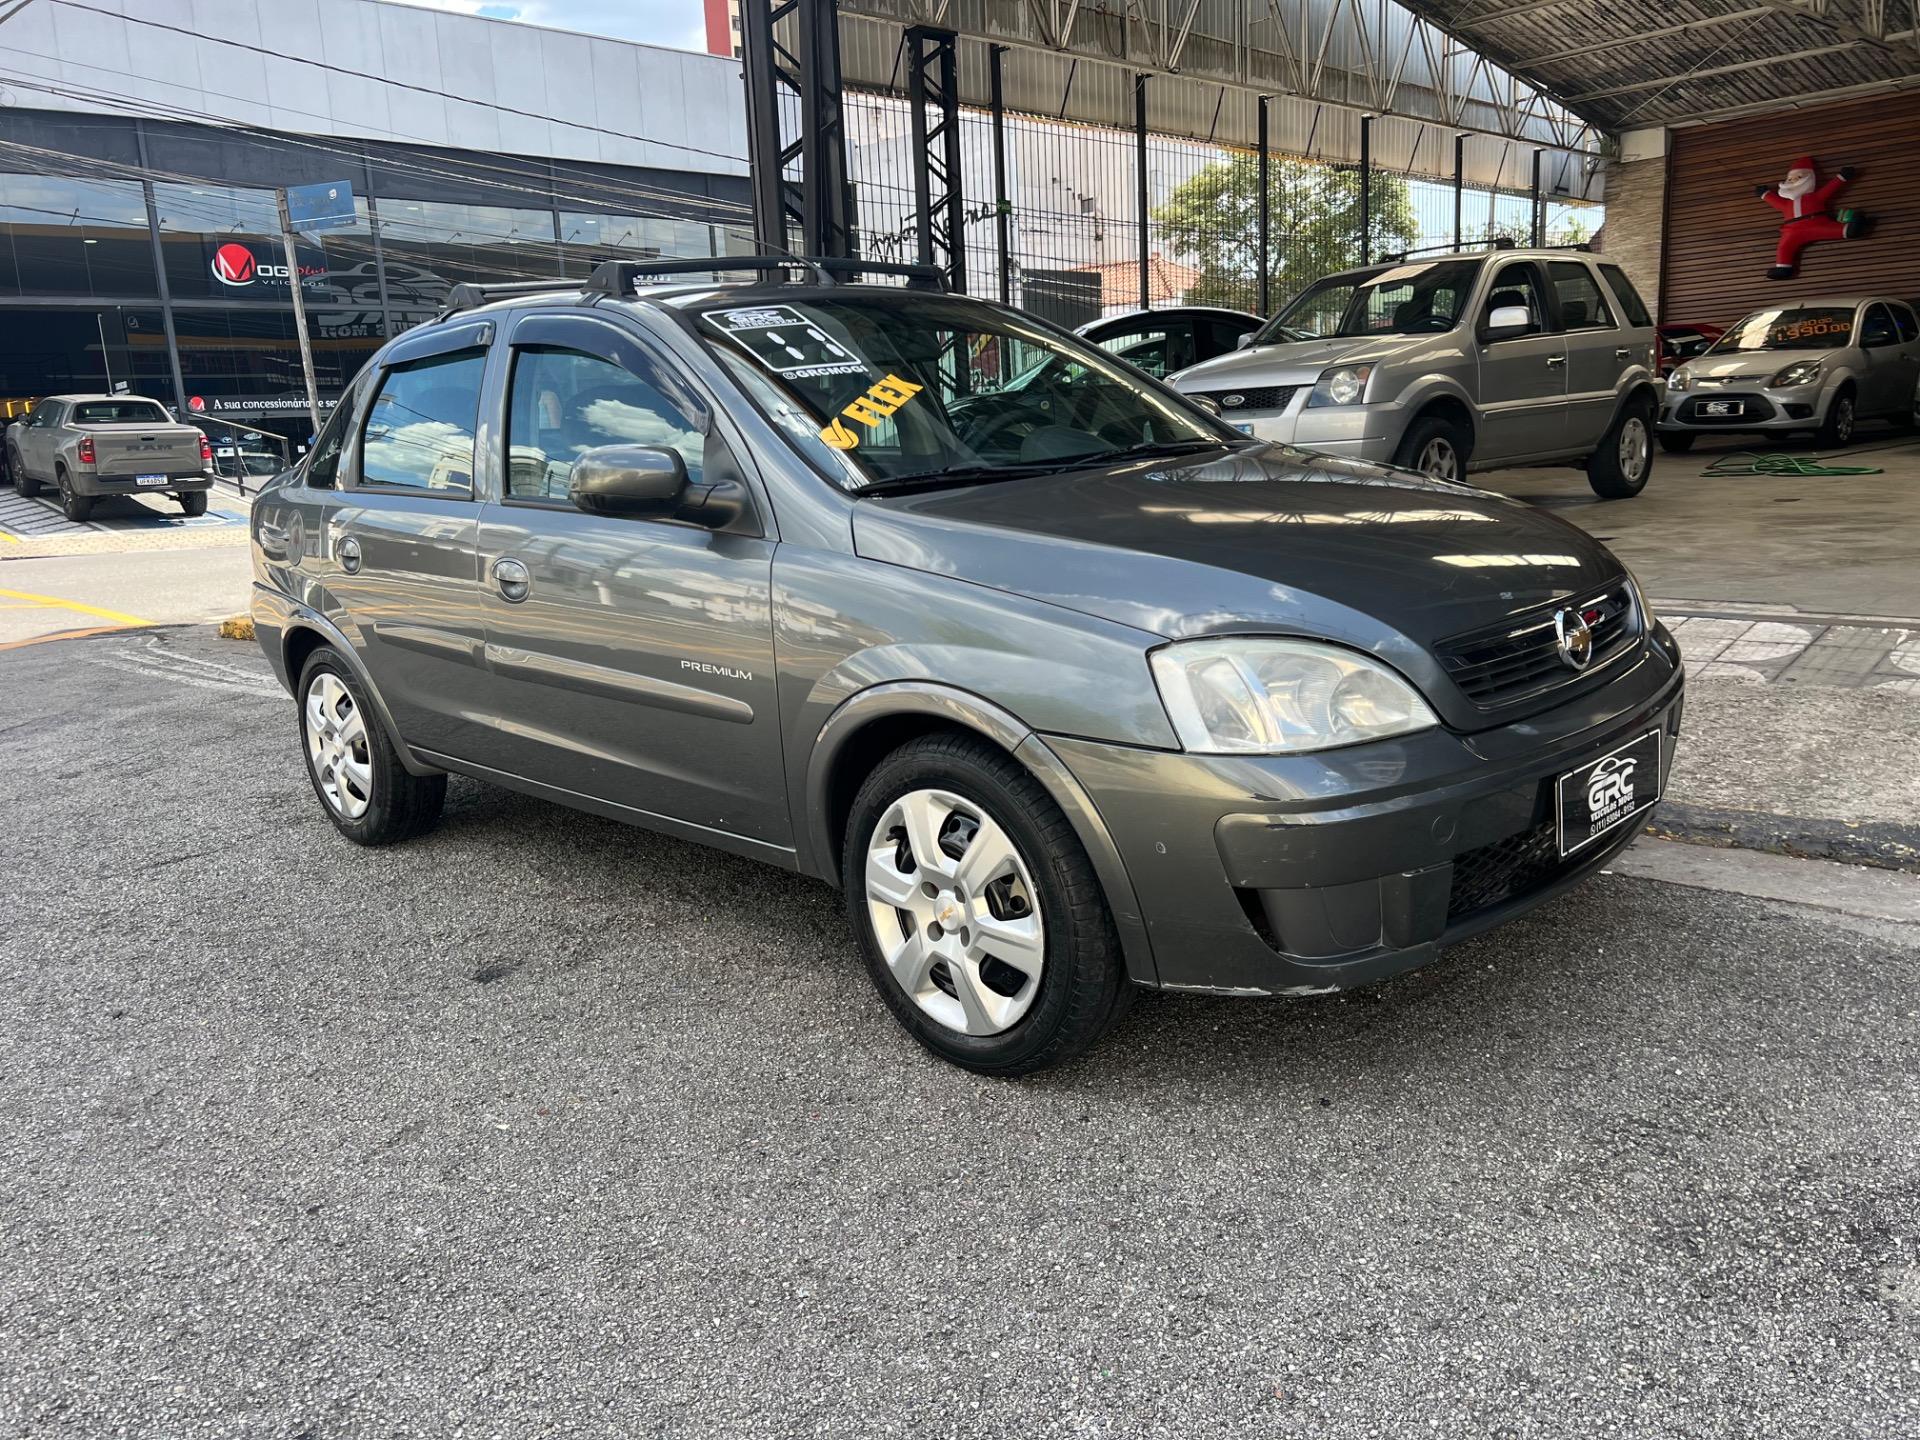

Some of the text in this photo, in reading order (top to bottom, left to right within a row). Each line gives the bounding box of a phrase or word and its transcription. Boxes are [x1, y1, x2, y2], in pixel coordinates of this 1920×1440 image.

[262, 279, 325, 287] VEICLOS
[213, 399, 222, 410] A
[224, 401, 241, 410] sua
[841, 373, 924, 428] FLEX
[680, 660, 753, 681] PREMIUM
[1588, 764, 1635, 812] GRC
